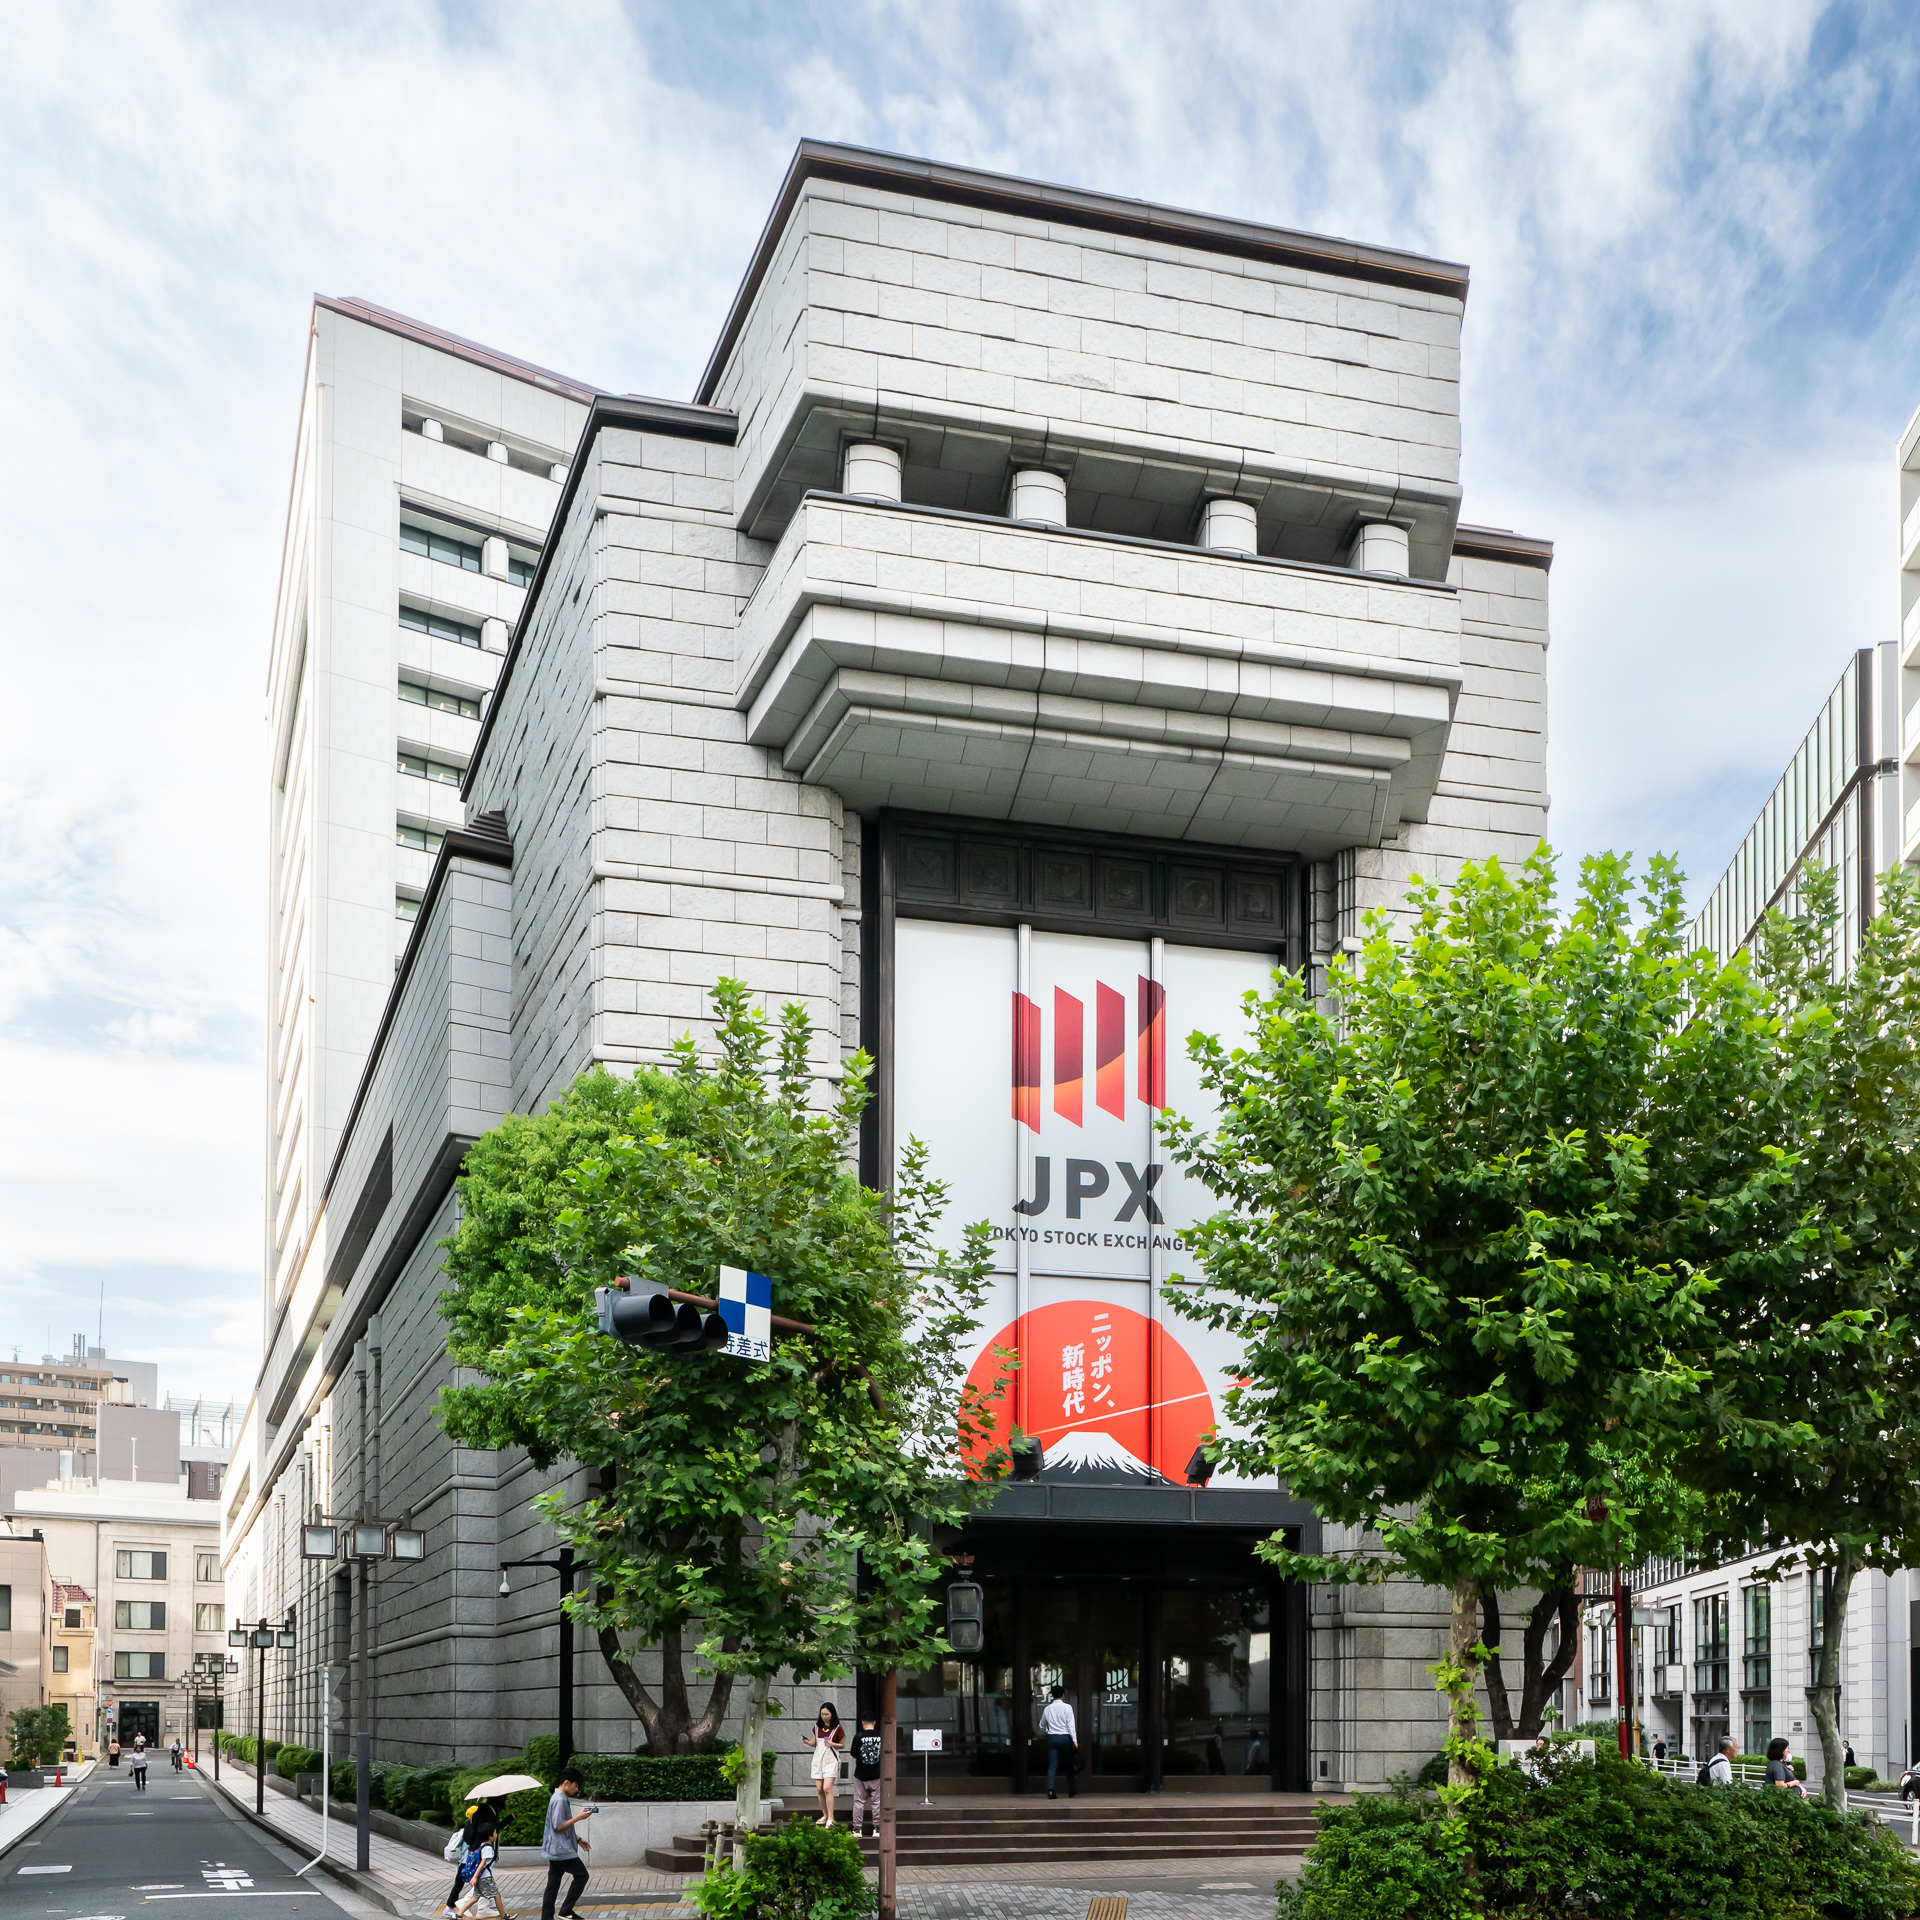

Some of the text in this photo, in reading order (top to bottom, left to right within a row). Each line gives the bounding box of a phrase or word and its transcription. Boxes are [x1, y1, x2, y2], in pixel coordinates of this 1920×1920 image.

[1011, 1155, 1165, 1225] JPX
[985, 1226, 1039, 1243] OKYO
[1043, 1229, 1099, 1247] STOCK
[1062, 1342, 1085, 1417] 新時代
[1090, 1312, 1115, 1408] ニッポン、
[1106, 1693, 1128, 1703] JPX
[860, 1736, 882, 1744] TOKYO
